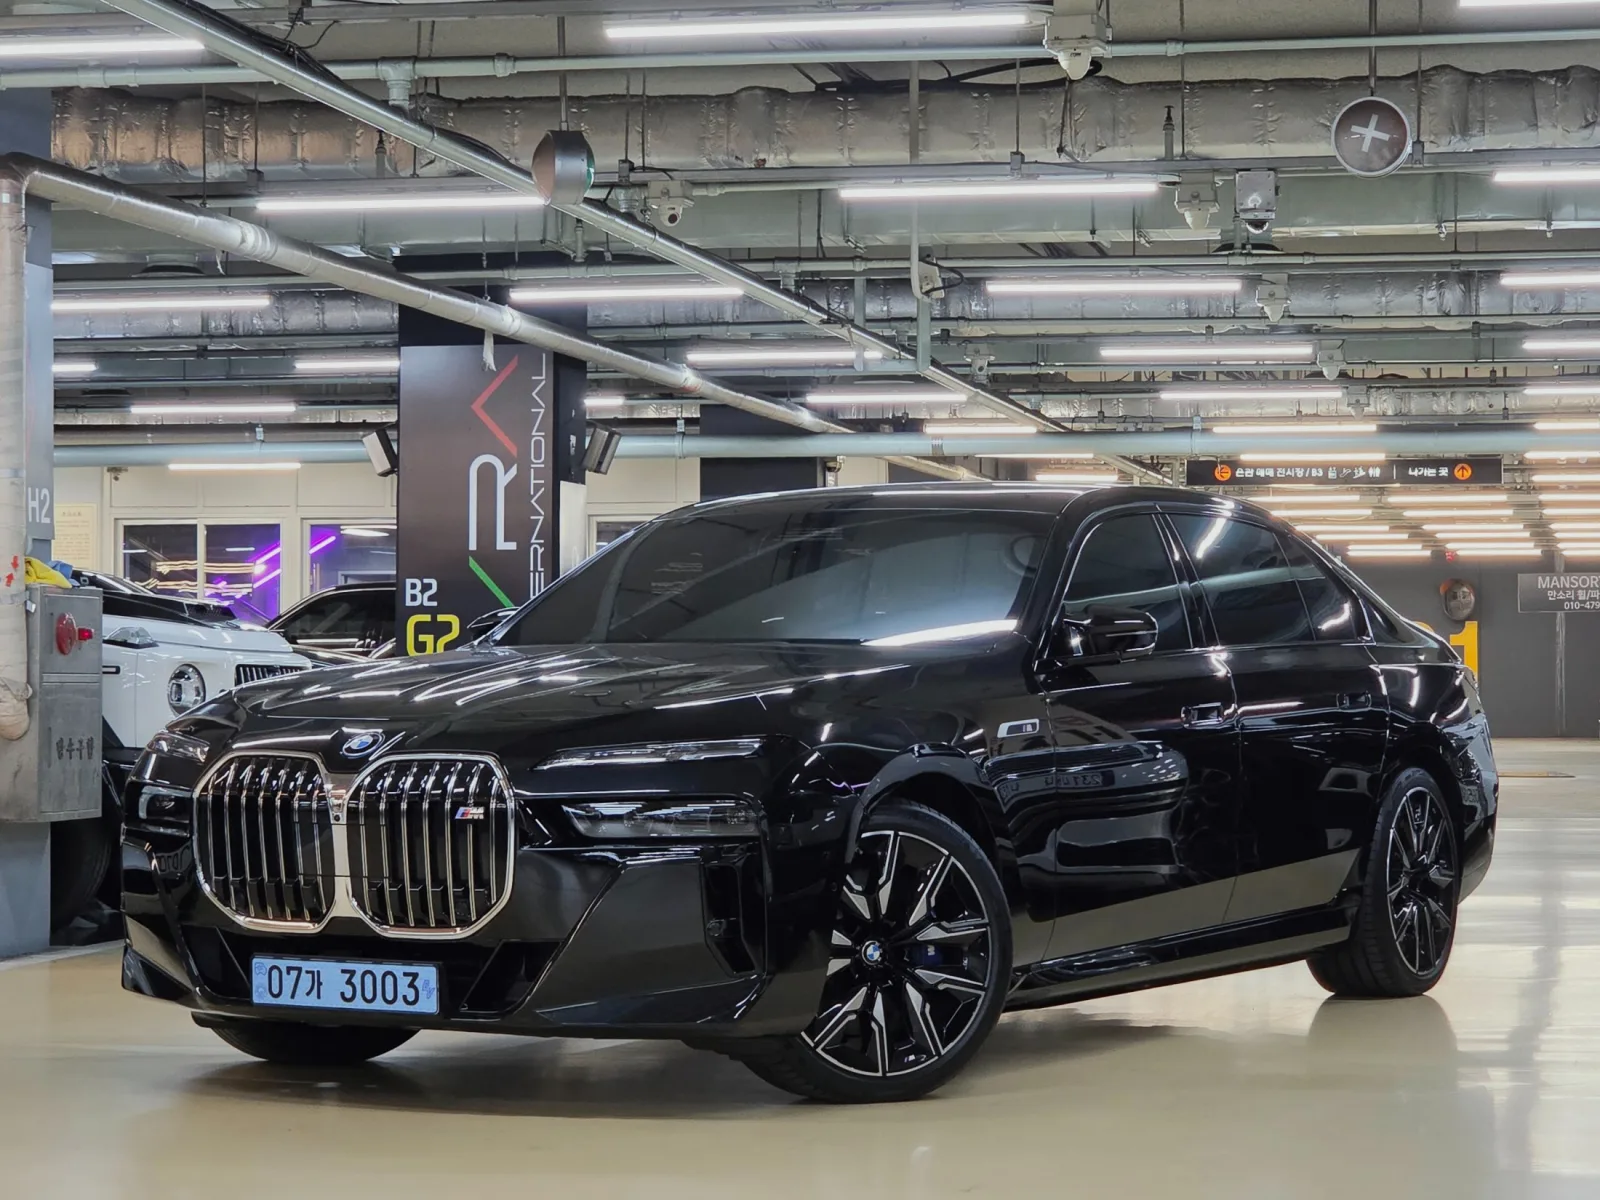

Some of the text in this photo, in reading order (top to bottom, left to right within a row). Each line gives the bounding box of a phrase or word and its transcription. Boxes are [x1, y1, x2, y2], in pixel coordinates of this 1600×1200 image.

[1408, 467, 1436, 477] 나가는
[28, 487, 51, 524] H2
[405, 578, 438, 607] B2
[1537, 575, 1600, 588] MANSOR
[1547, 590, 1575, 600] 만소리
[406, 614, 460, 657] G2
[267, 965, 323, 999] 07가
[340, 969, 420, 1006] 3003
